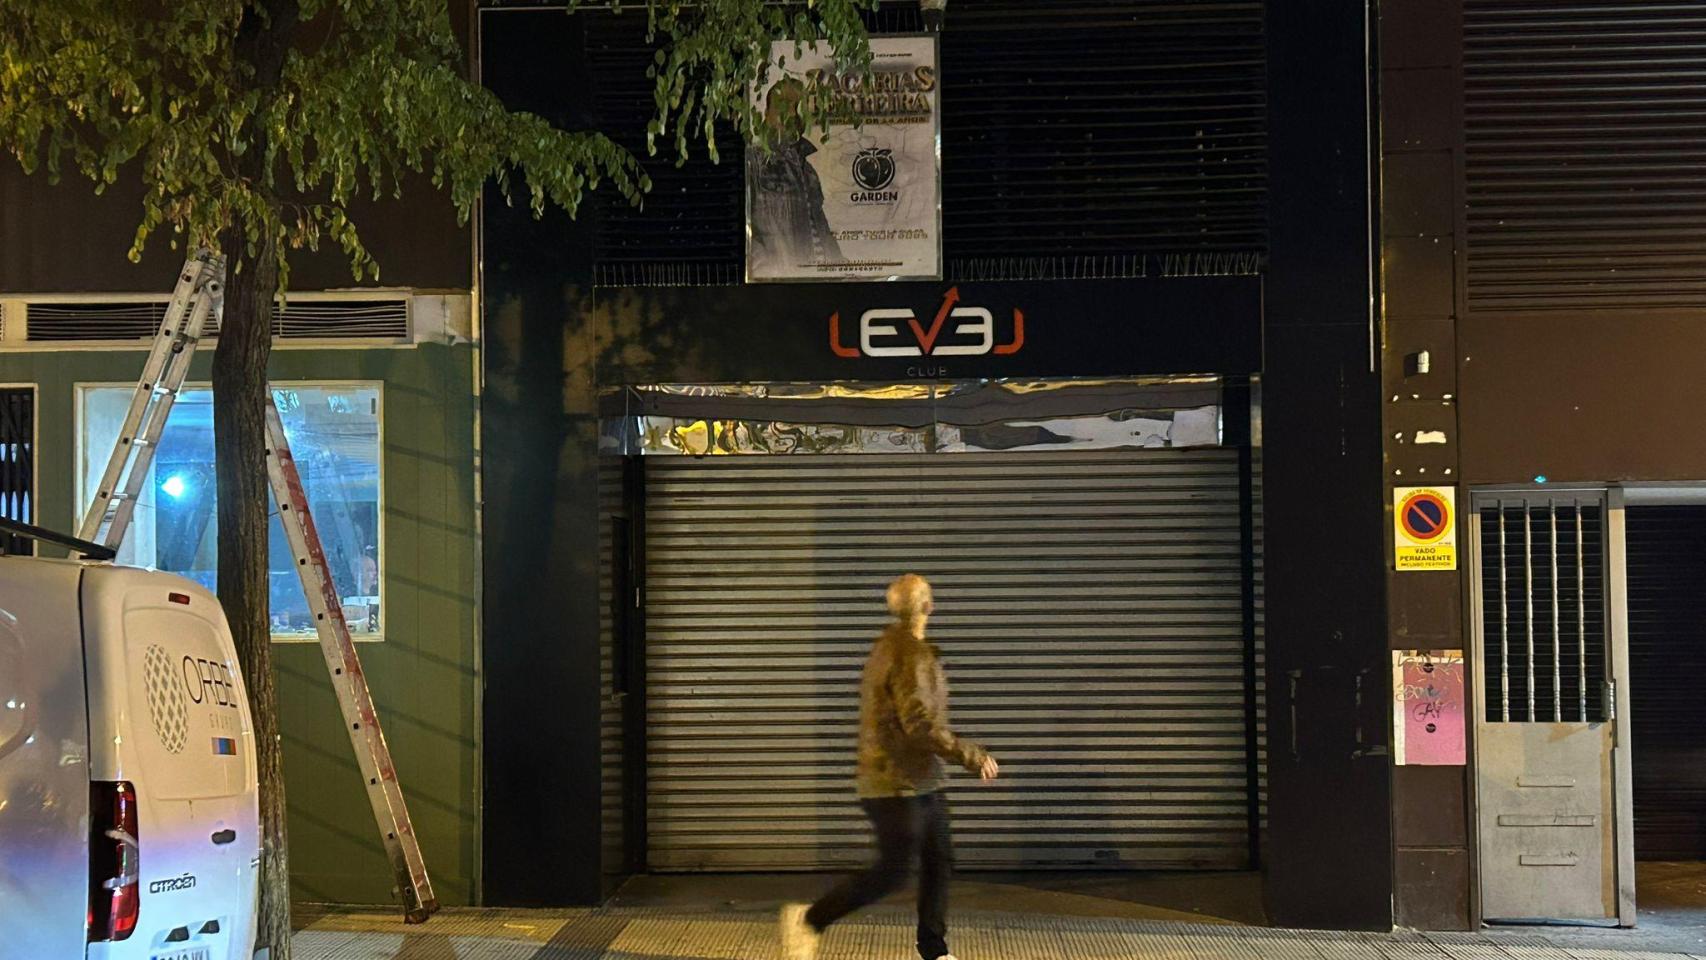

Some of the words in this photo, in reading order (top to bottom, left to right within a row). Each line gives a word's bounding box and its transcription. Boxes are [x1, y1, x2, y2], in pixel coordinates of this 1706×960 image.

[850, 191, 899, 202] GARDEN
[829, 286, 1024, 357] LEVEL
[906, 366, 947, 377] CLUB
[1399, 554, 1452, 562] PERMANENTE
